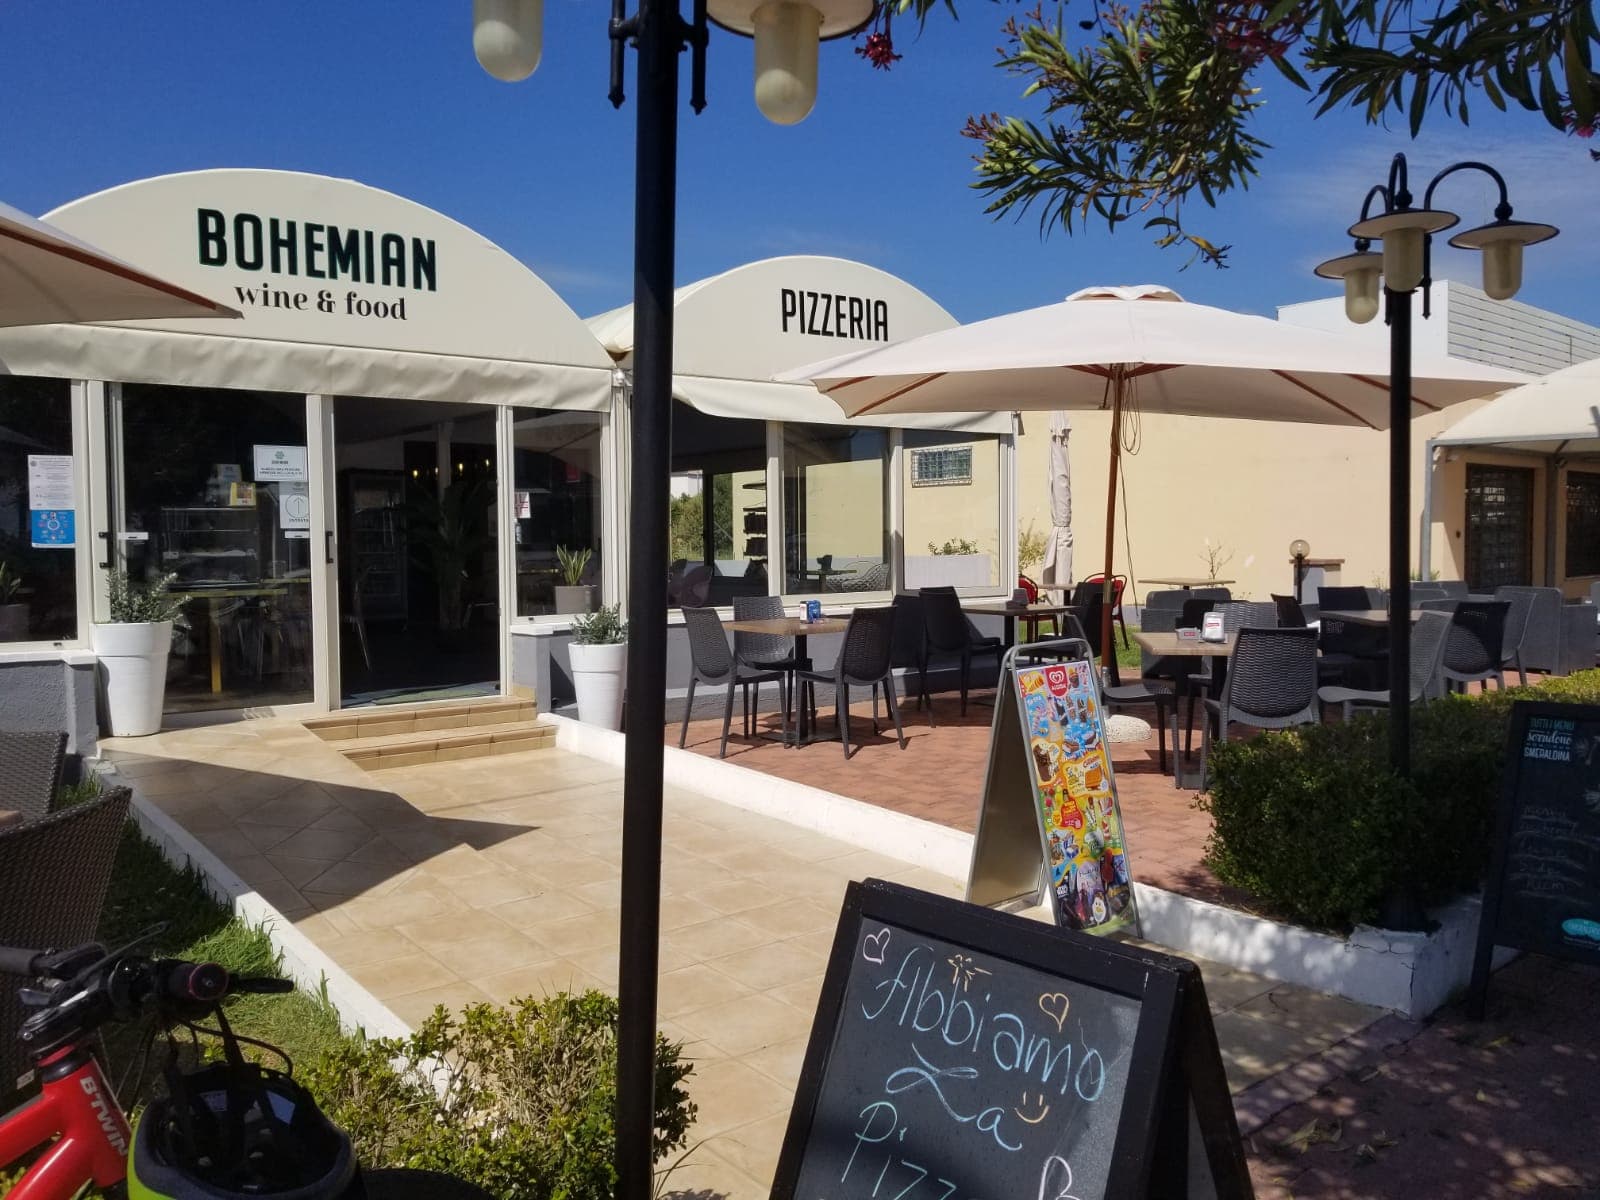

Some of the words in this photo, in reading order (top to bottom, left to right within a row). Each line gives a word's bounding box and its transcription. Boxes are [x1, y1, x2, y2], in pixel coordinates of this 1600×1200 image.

[197, 207, 437, 292] BOHEMIAN
[234, 282, 309, 311] wine
[316, 289, 337, 313] &
[346, 291, 408, 321] food
[781, 287, 889, 342] PIZZERIA
[861, 943, 1106, 1102] Abbiamo
[885, 1041, 1024, 1152] La
